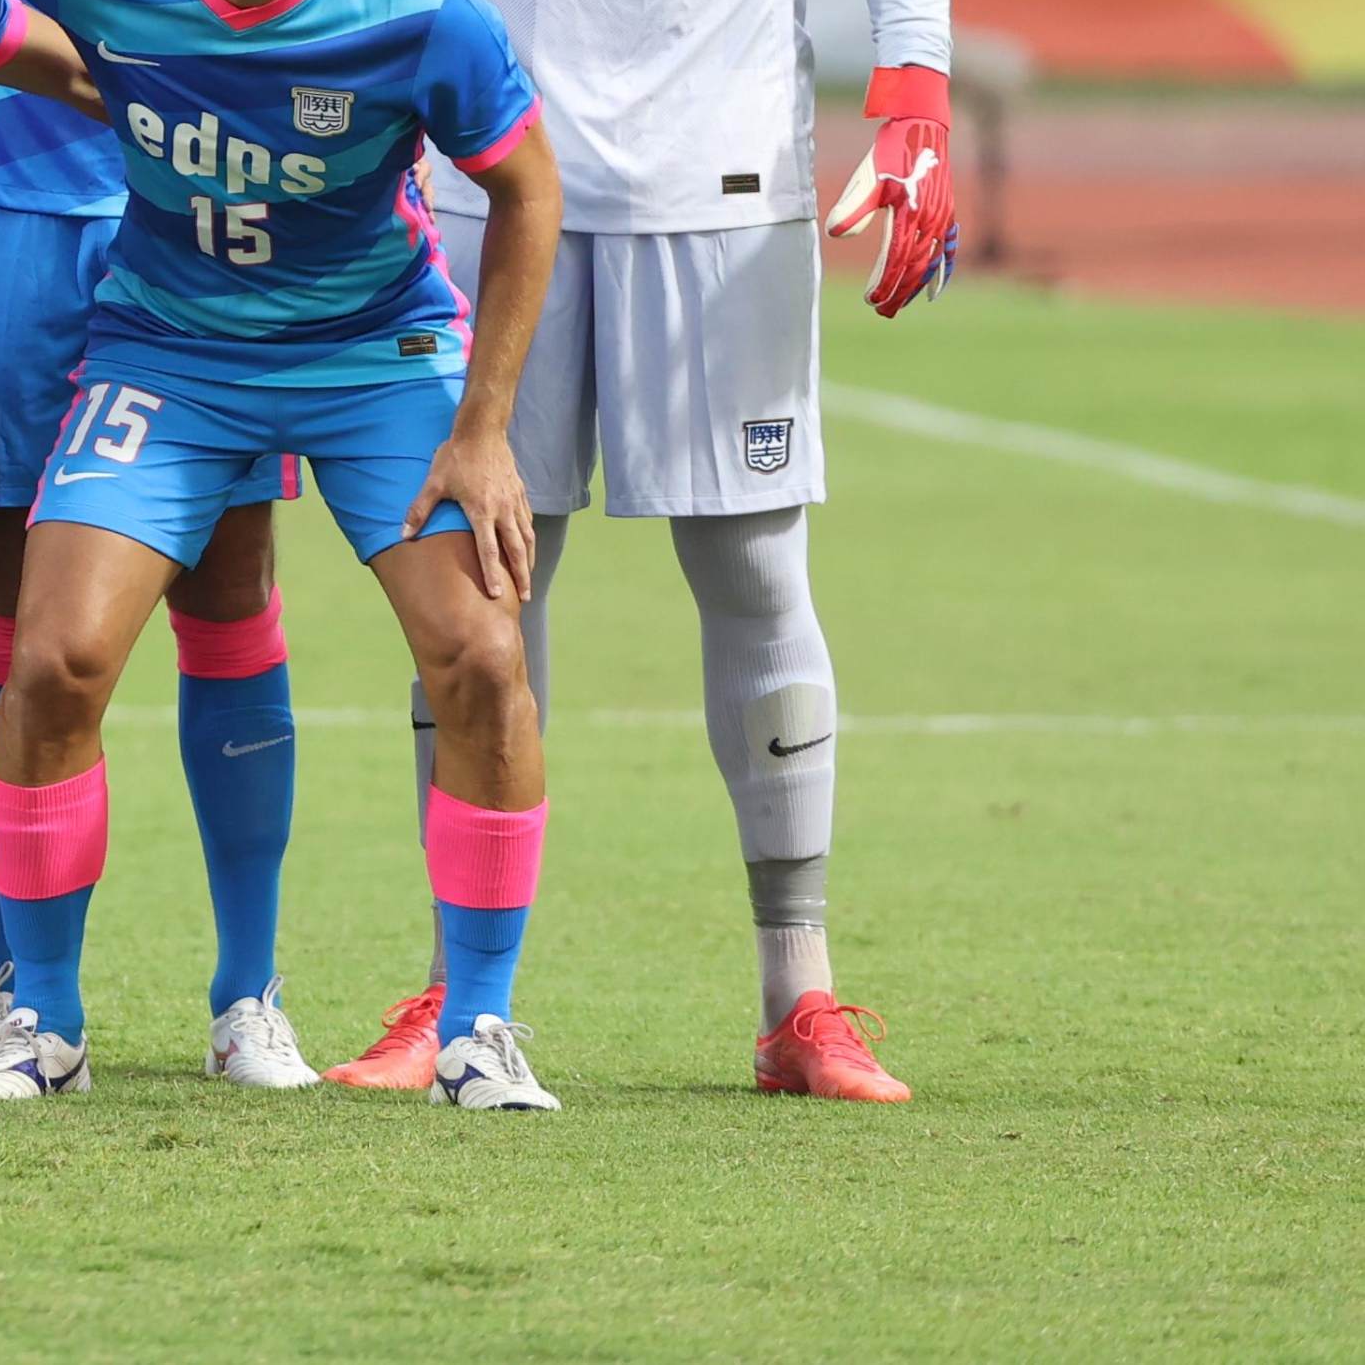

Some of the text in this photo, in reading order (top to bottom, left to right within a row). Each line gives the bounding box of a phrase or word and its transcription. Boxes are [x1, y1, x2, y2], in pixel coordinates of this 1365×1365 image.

[127, 102, 327, 194] edps
[190, 195, 272, 266] 15
[64, 382, 163, 464] 15
